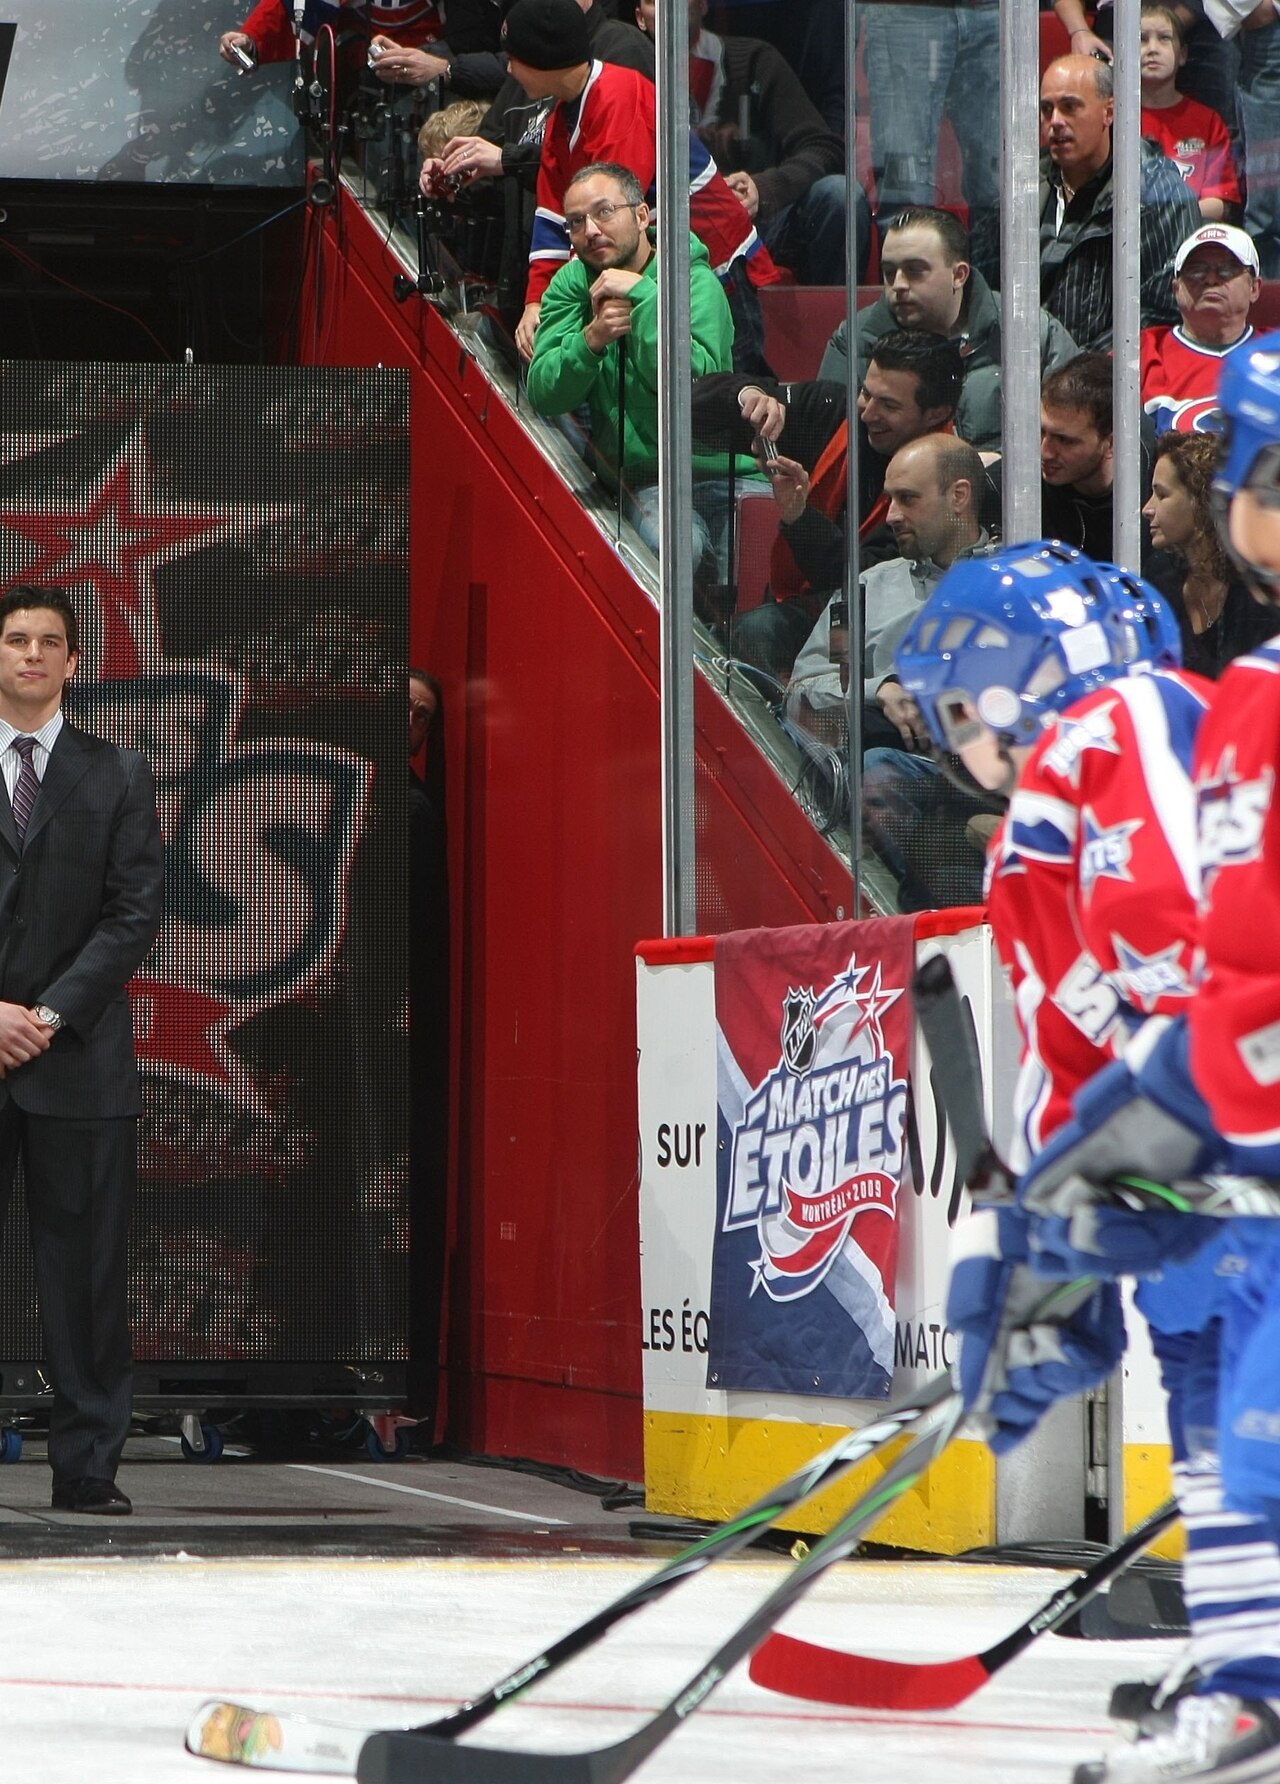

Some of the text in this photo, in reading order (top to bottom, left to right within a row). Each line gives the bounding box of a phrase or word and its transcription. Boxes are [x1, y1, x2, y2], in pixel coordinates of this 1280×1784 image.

[767, 1063, 886, 1131] MATCH DES
[657, 1123, 706, 1168] sur
[731, 1092, 907, 1217] ÉTOILES
[801, 1179, 883, 1223] MONTRÉAL 2009
